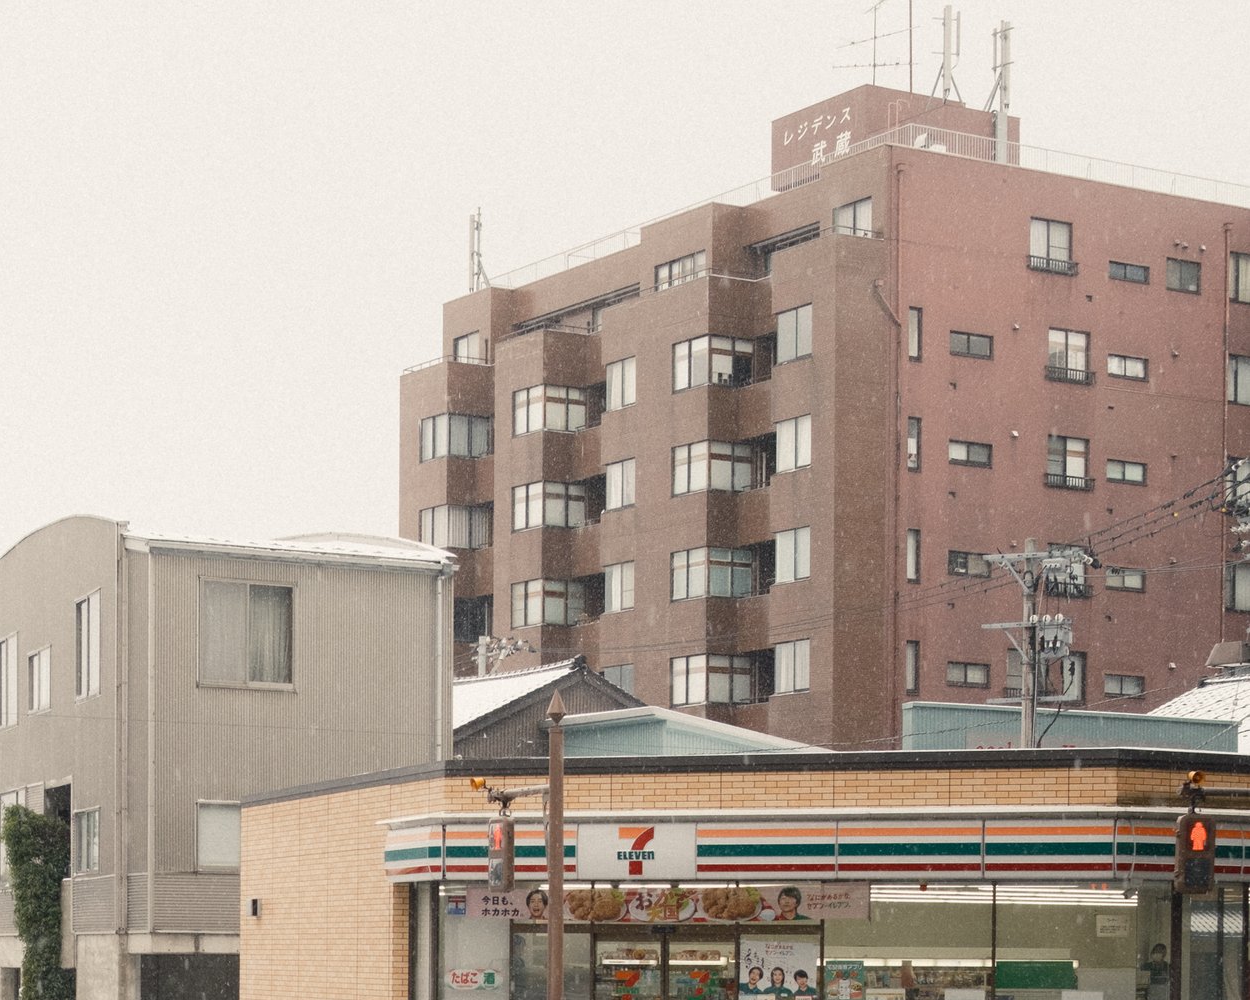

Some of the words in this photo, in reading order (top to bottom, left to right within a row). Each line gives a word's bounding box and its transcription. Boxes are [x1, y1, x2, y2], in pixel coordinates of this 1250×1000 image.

[783, 107, 851, 146] レジデンス
[811, 131, 851, 165] 武蔵
[481, 895, 514, 905] 今日も、
[452, 972, 478, 984] たばこ
[483, 972, 495, 984] 酒
